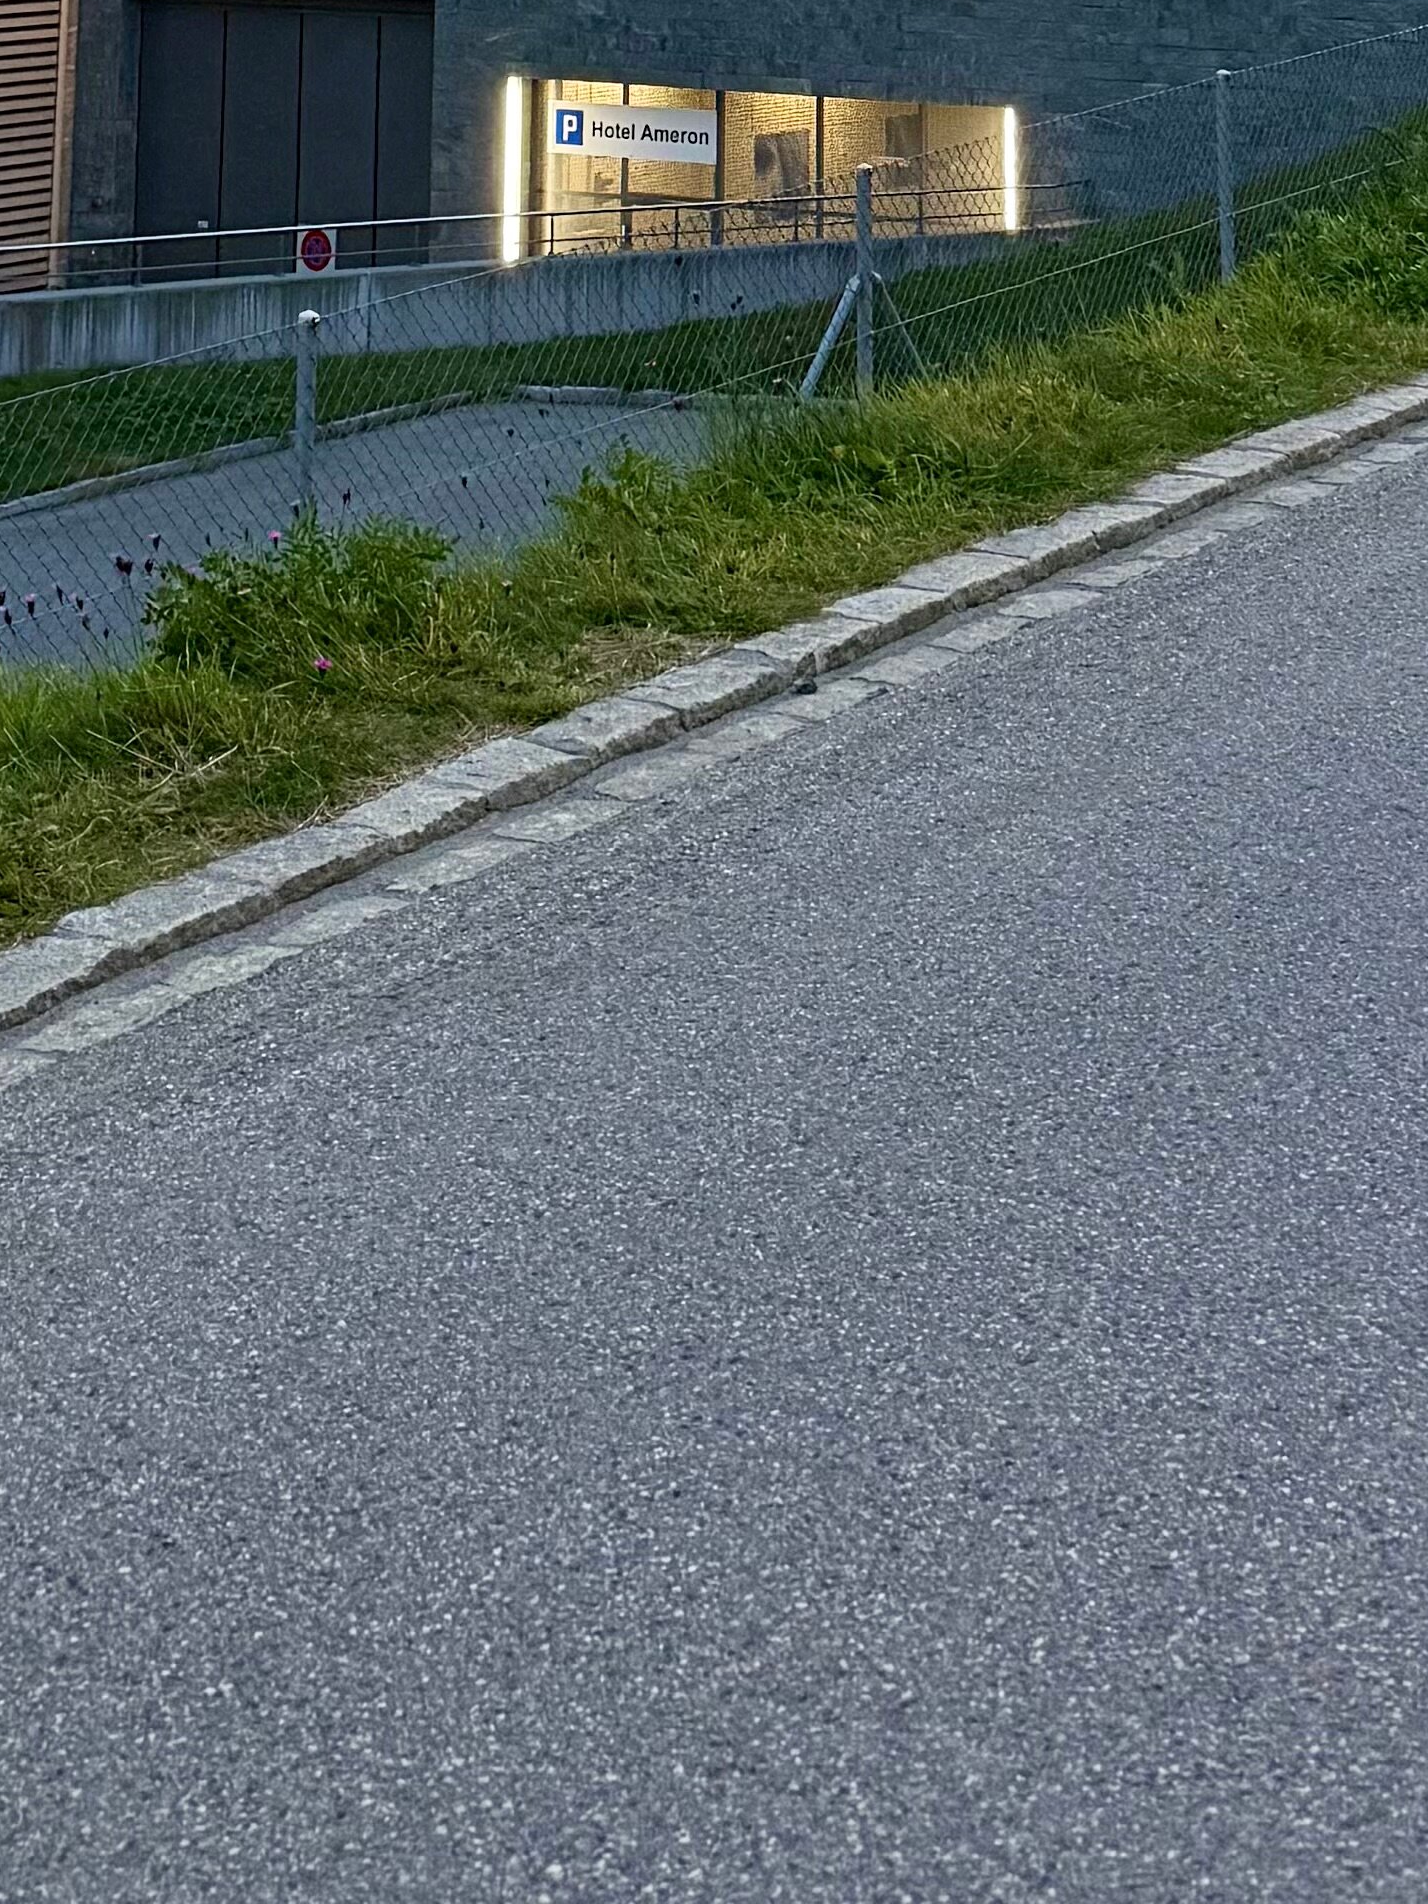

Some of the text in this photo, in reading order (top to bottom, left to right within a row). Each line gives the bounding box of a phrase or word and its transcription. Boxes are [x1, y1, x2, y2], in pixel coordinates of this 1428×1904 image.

[562, 114, 709, 145] P Hotel Ameron
